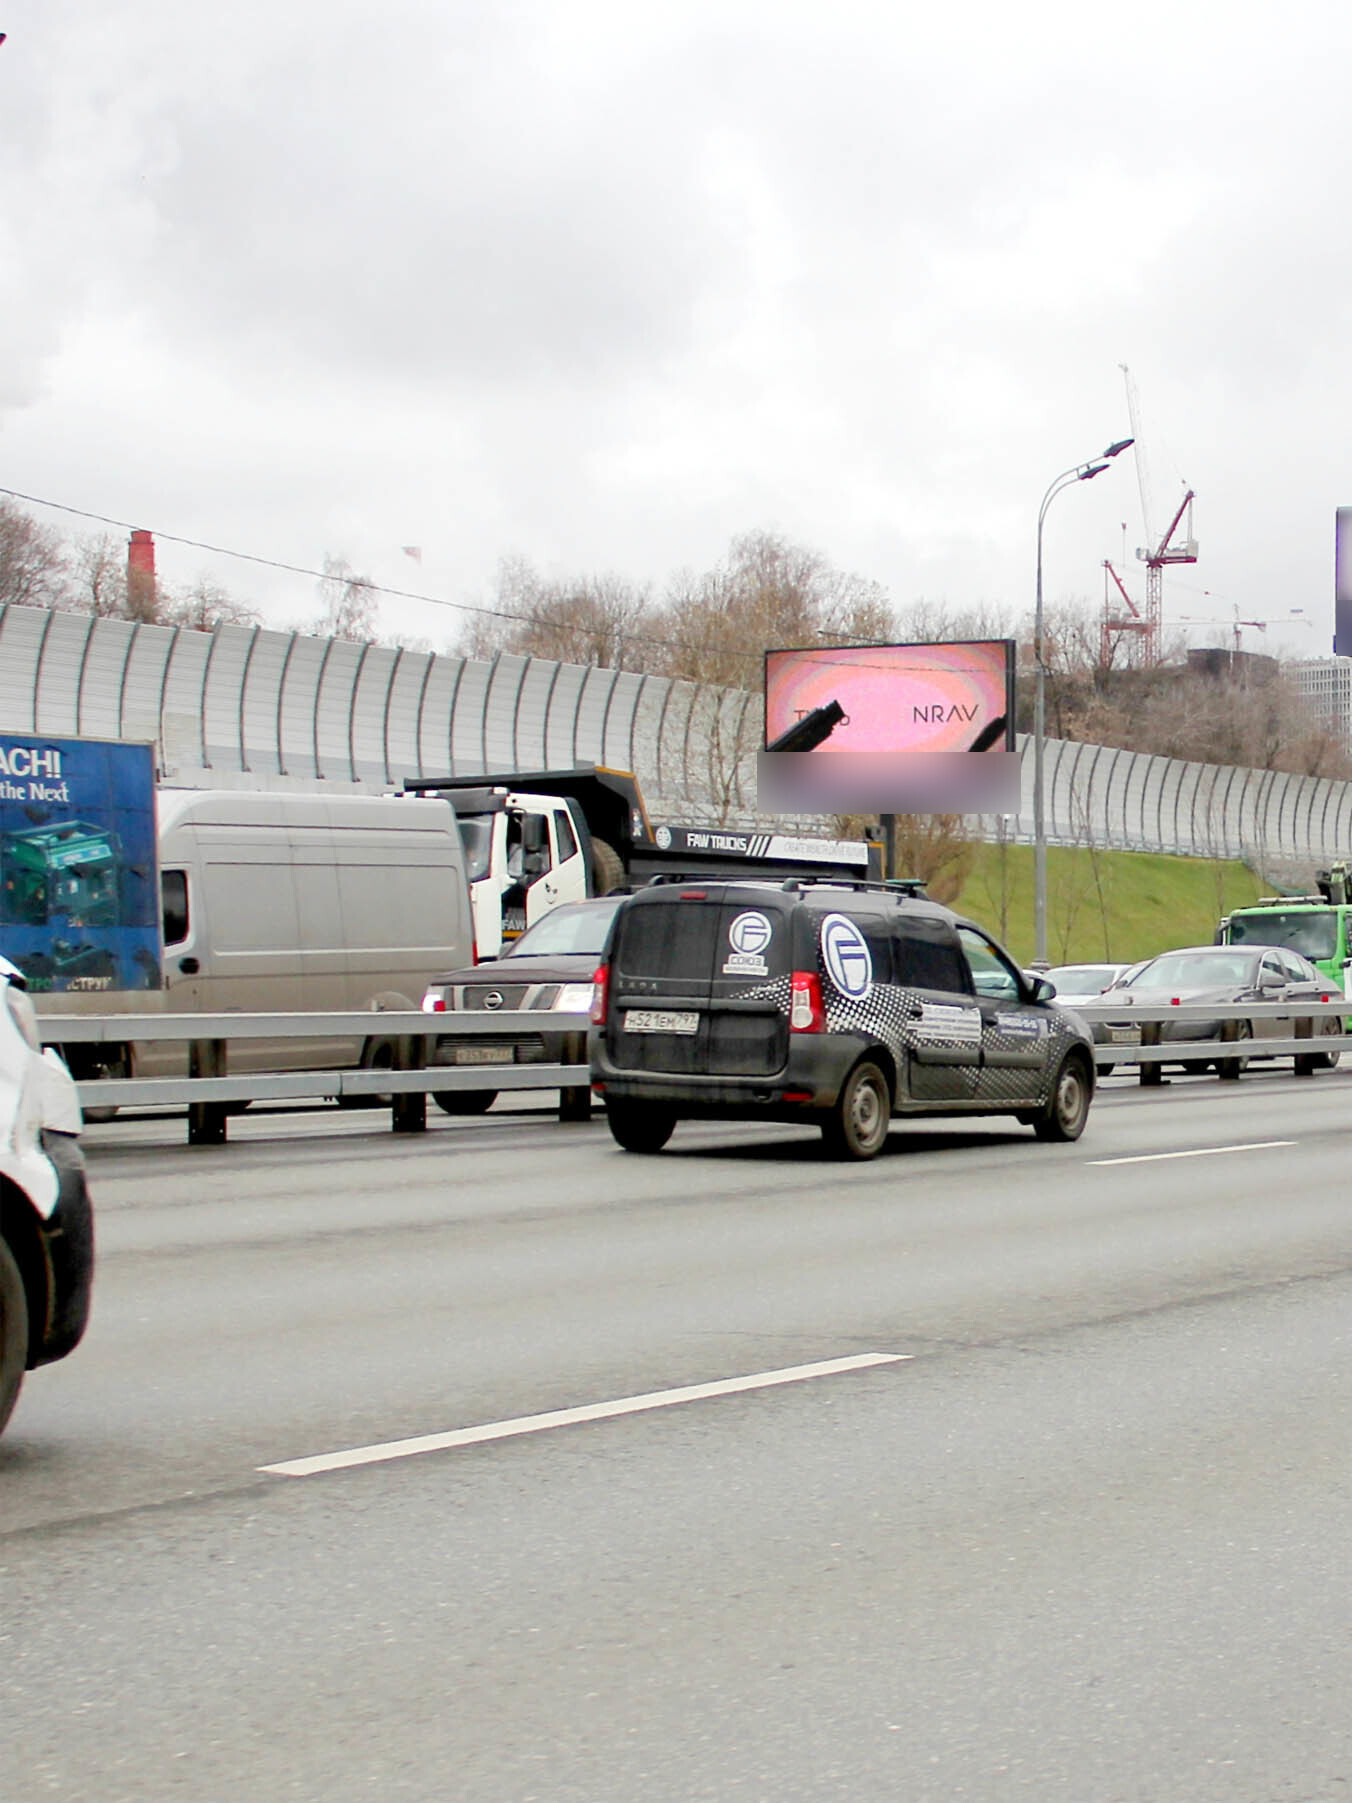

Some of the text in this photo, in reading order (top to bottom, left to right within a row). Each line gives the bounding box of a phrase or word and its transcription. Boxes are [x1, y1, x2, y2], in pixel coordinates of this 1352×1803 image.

[29, 781, 70, 802] Next
[687, 832, 747, 851] FAW TRUCKS
[501, 919, 526, 930] FAW
